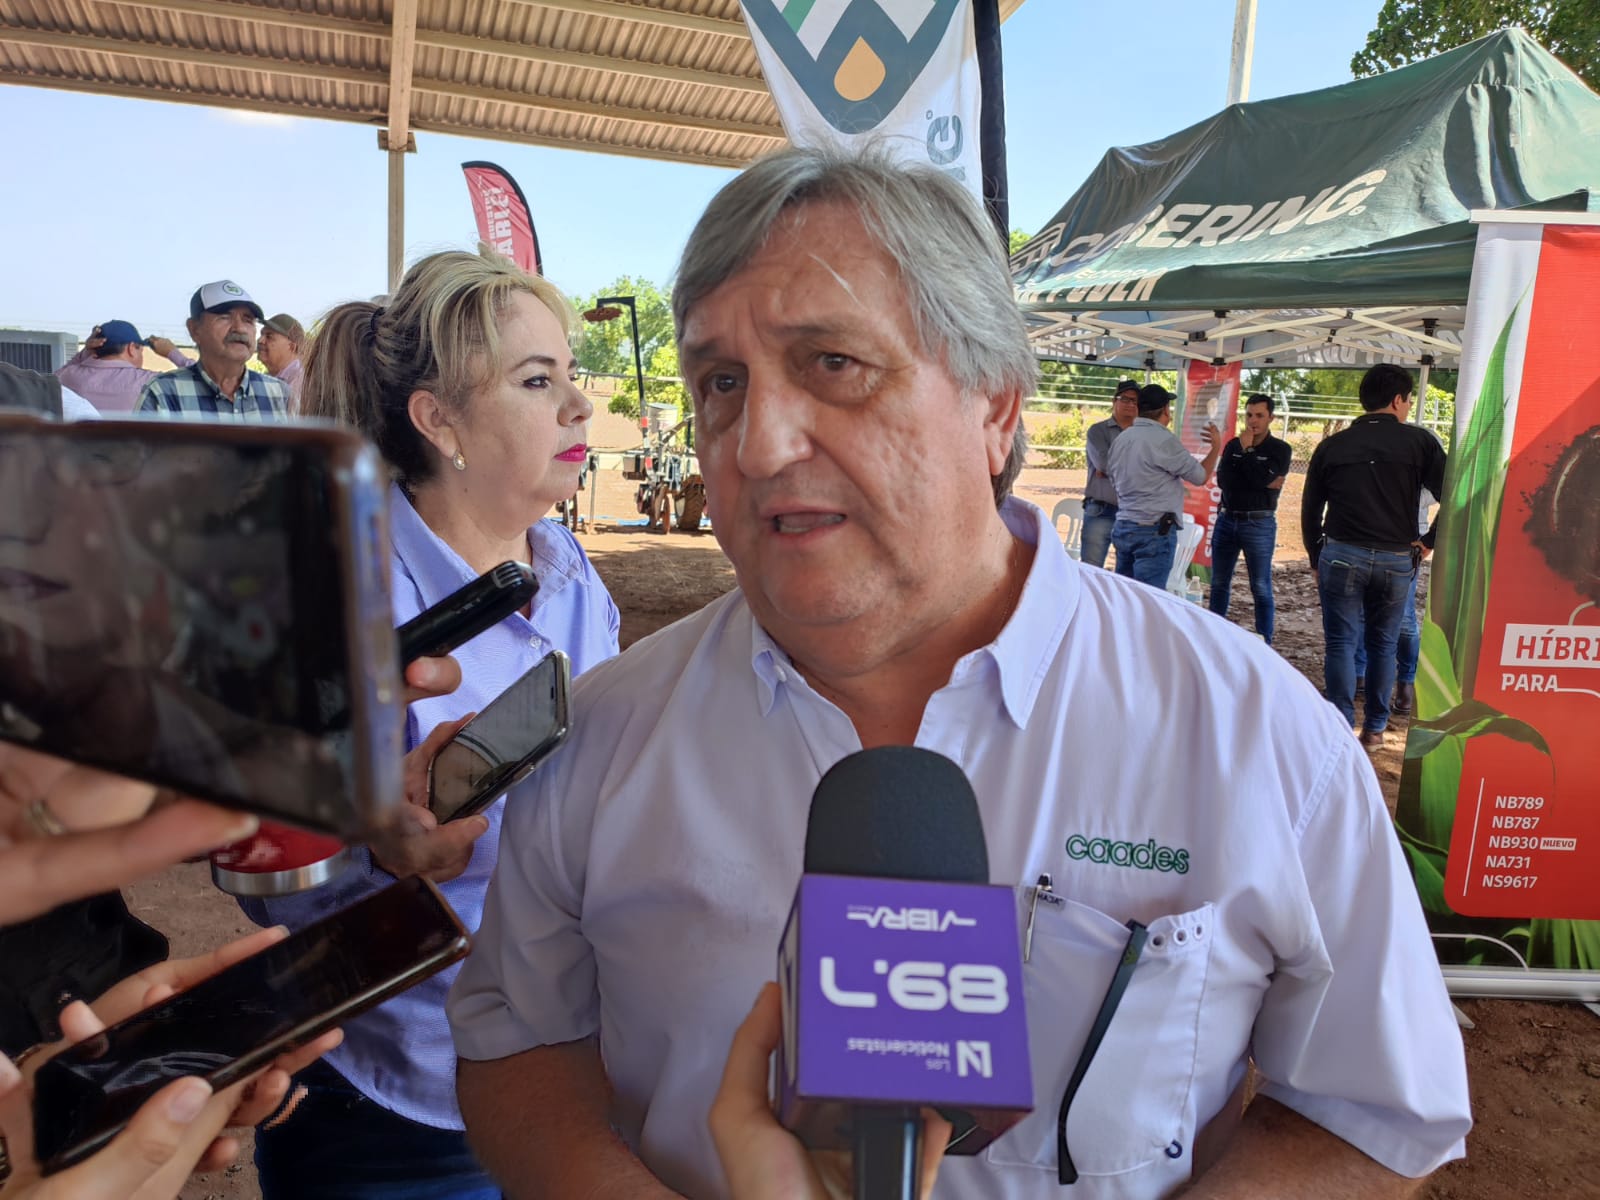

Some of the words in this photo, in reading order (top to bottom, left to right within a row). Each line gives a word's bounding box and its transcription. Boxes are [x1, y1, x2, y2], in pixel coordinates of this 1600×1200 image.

[1501, 673, 1558, 692] PARA
[1495, 795, 1545, 810] NB789
[1491, 815, 1540, 830] NB787
[1488, 835, 1539, 849] NB930
[1541, 838, 1575, 849] NUEVO
[1065, 834, 1190, 875] caades
[1485, 855, 1531, 869] NA731
[1482, 874, 1538, 889] NS9617
[847, 906, 977, 932] VIBRA
[820, 956, 1010, 1015] 89.7
[847, 1037, 950, 1057] Noticieristas
[926, 1058, 951, 1073] Los
